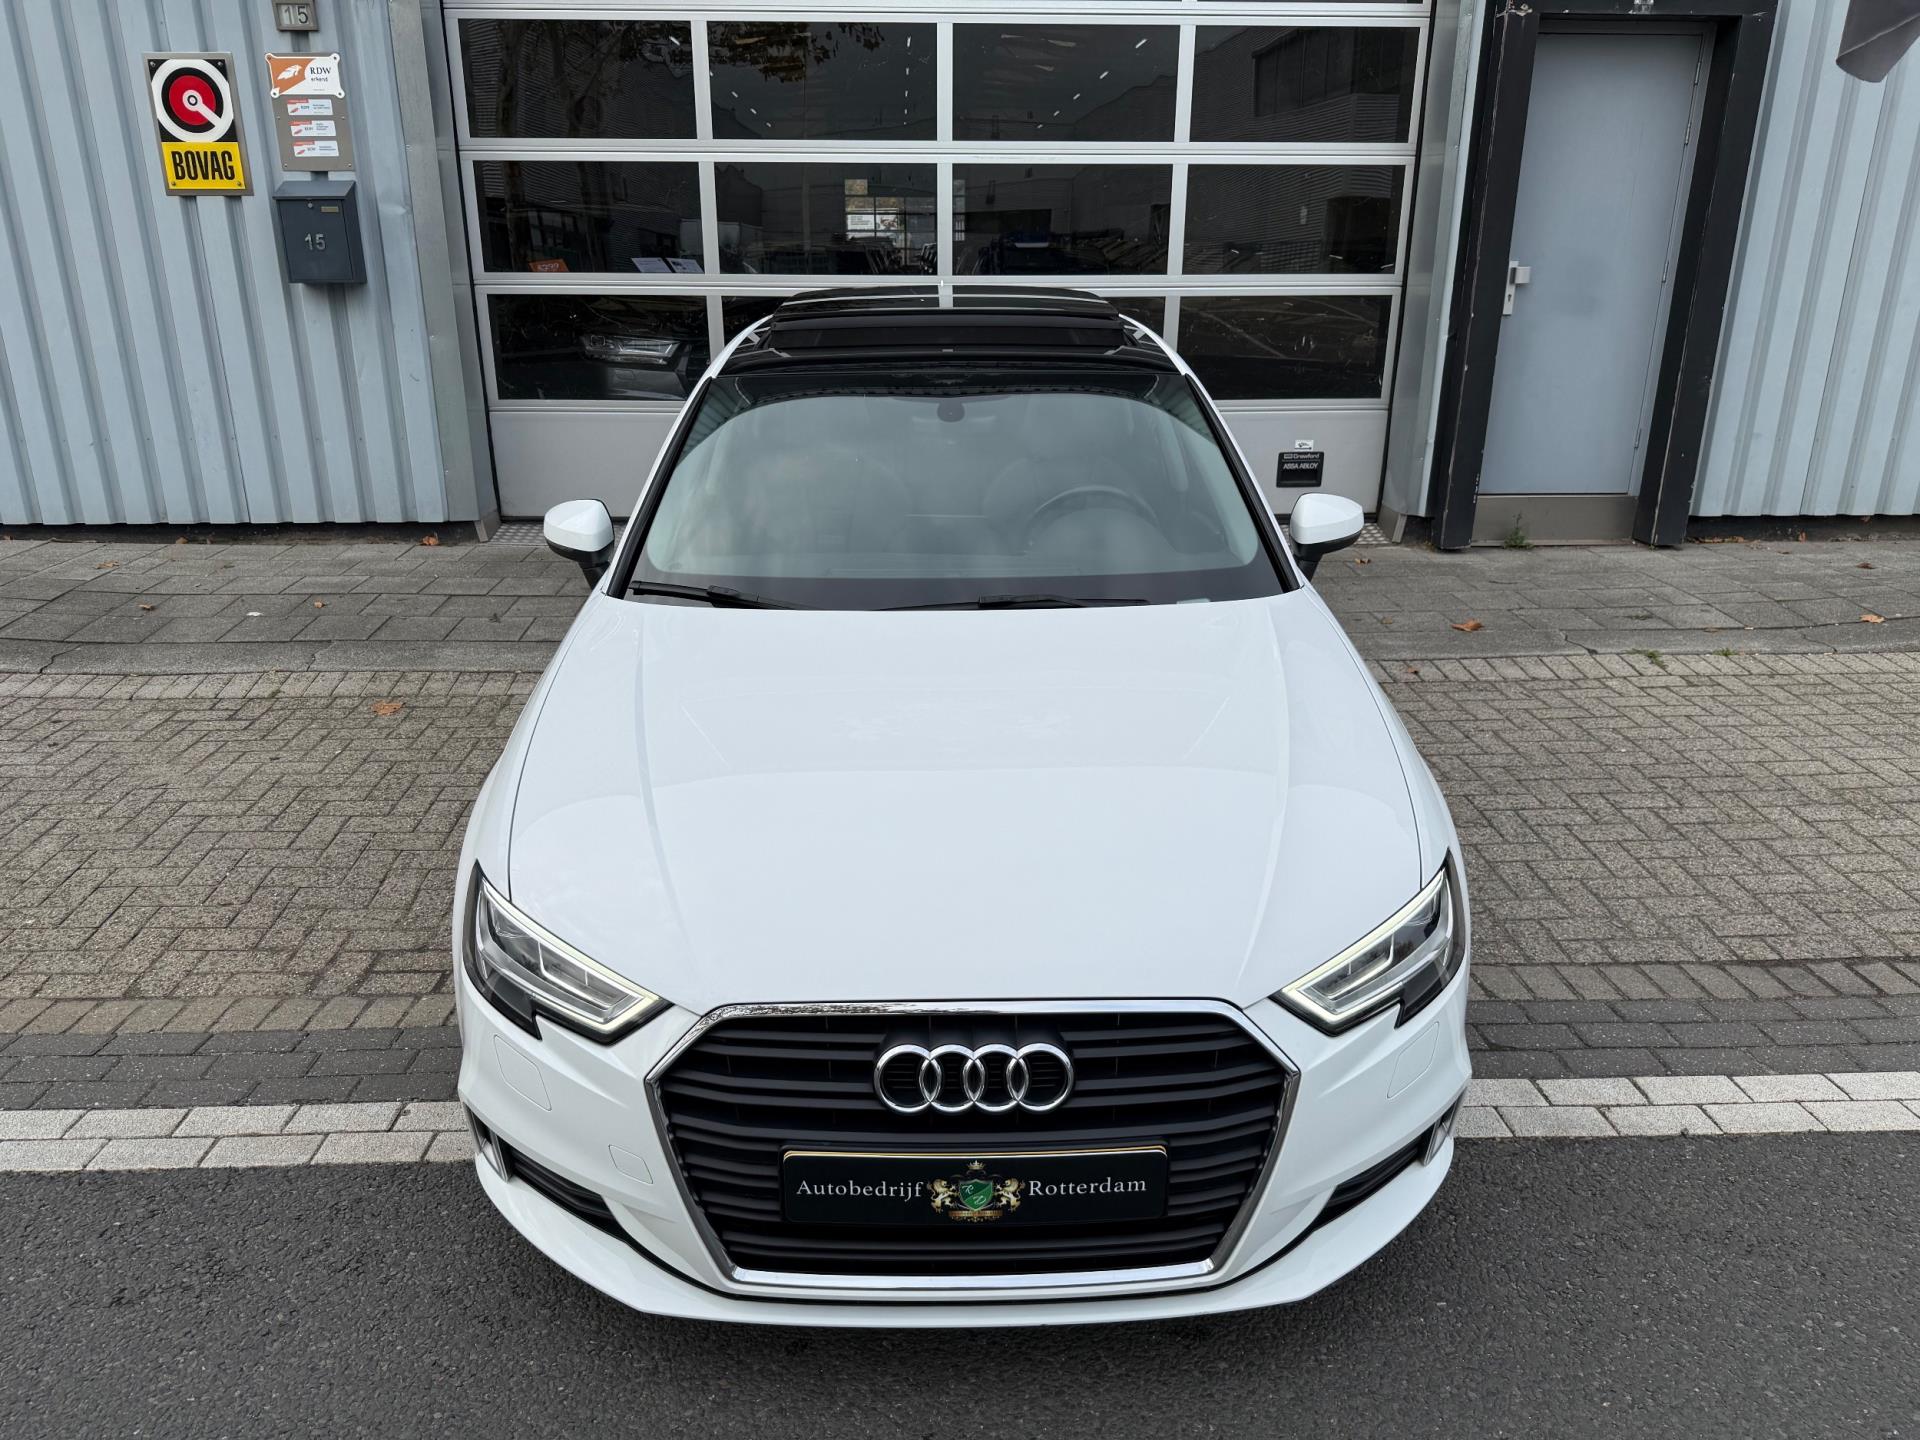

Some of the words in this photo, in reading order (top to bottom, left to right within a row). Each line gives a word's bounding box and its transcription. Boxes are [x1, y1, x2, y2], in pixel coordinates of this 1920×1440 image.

[284, 5, 309, 24] 15
[310, 66, 331, 75] RDW
[171, 150, 235, 180] BOVAG
[305, 233, 326, 250] 15
[796, 1180, 924, 1202] Autobedrijf
[1028, 1176, 1147, 1196] Rotterdam
